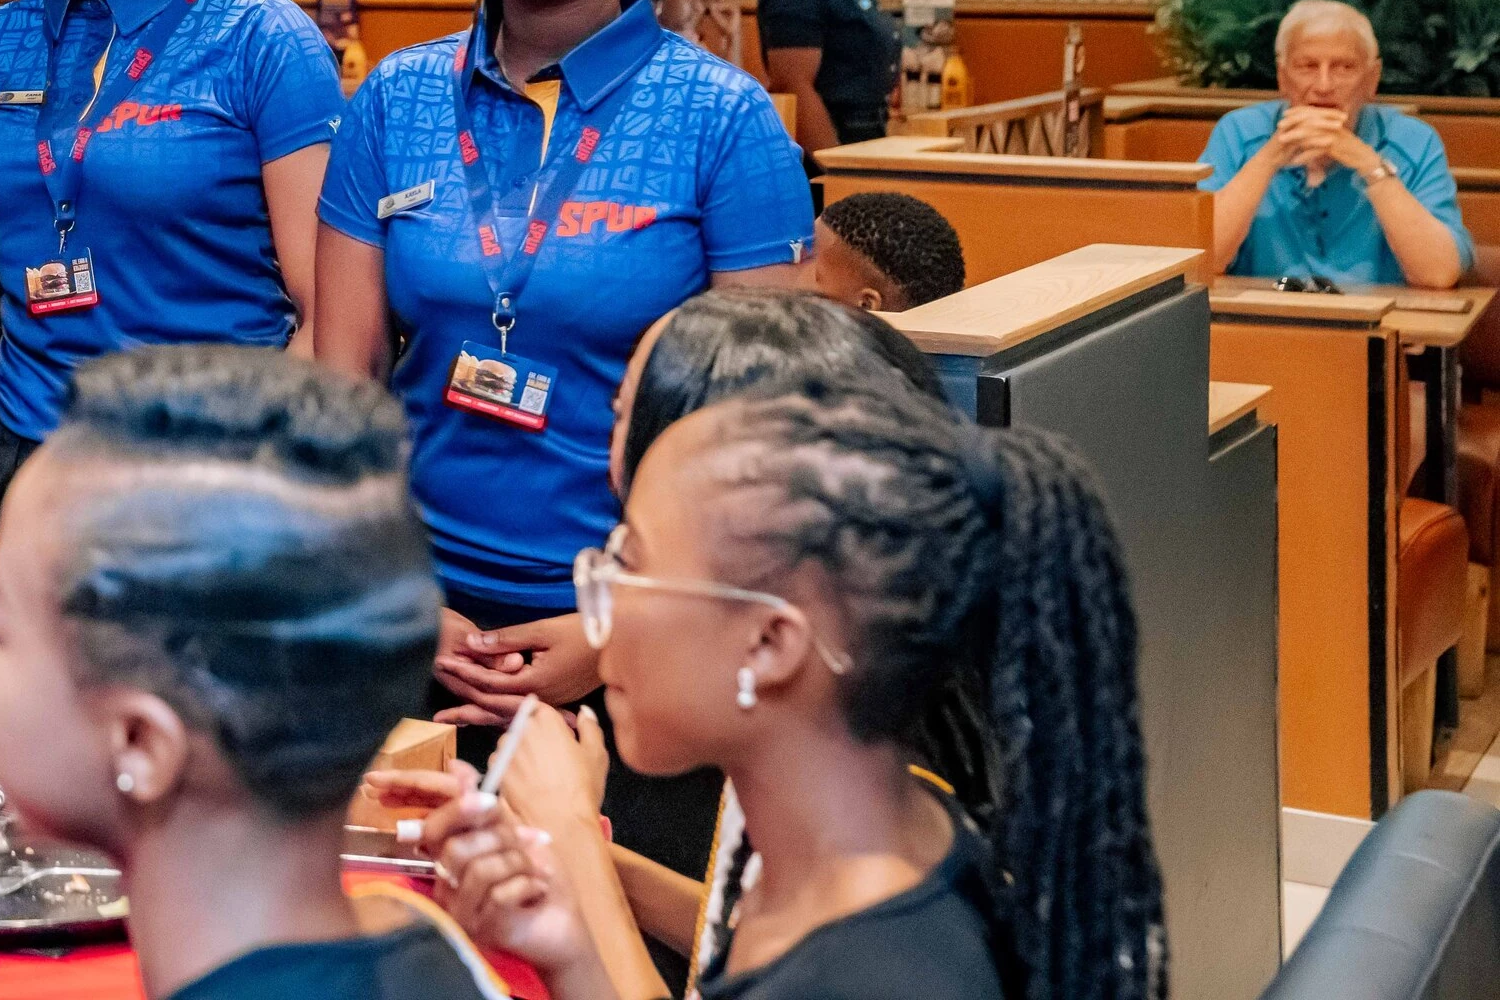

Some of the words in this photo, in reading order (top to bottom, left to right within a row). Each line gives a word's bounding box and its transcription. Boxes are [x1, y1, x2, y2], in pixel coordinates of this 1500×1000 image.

[127, 47, 153, 81] SPUR
[575, 126, 601, 163] SPUR
[555, 201, 657, 237] SPUR
